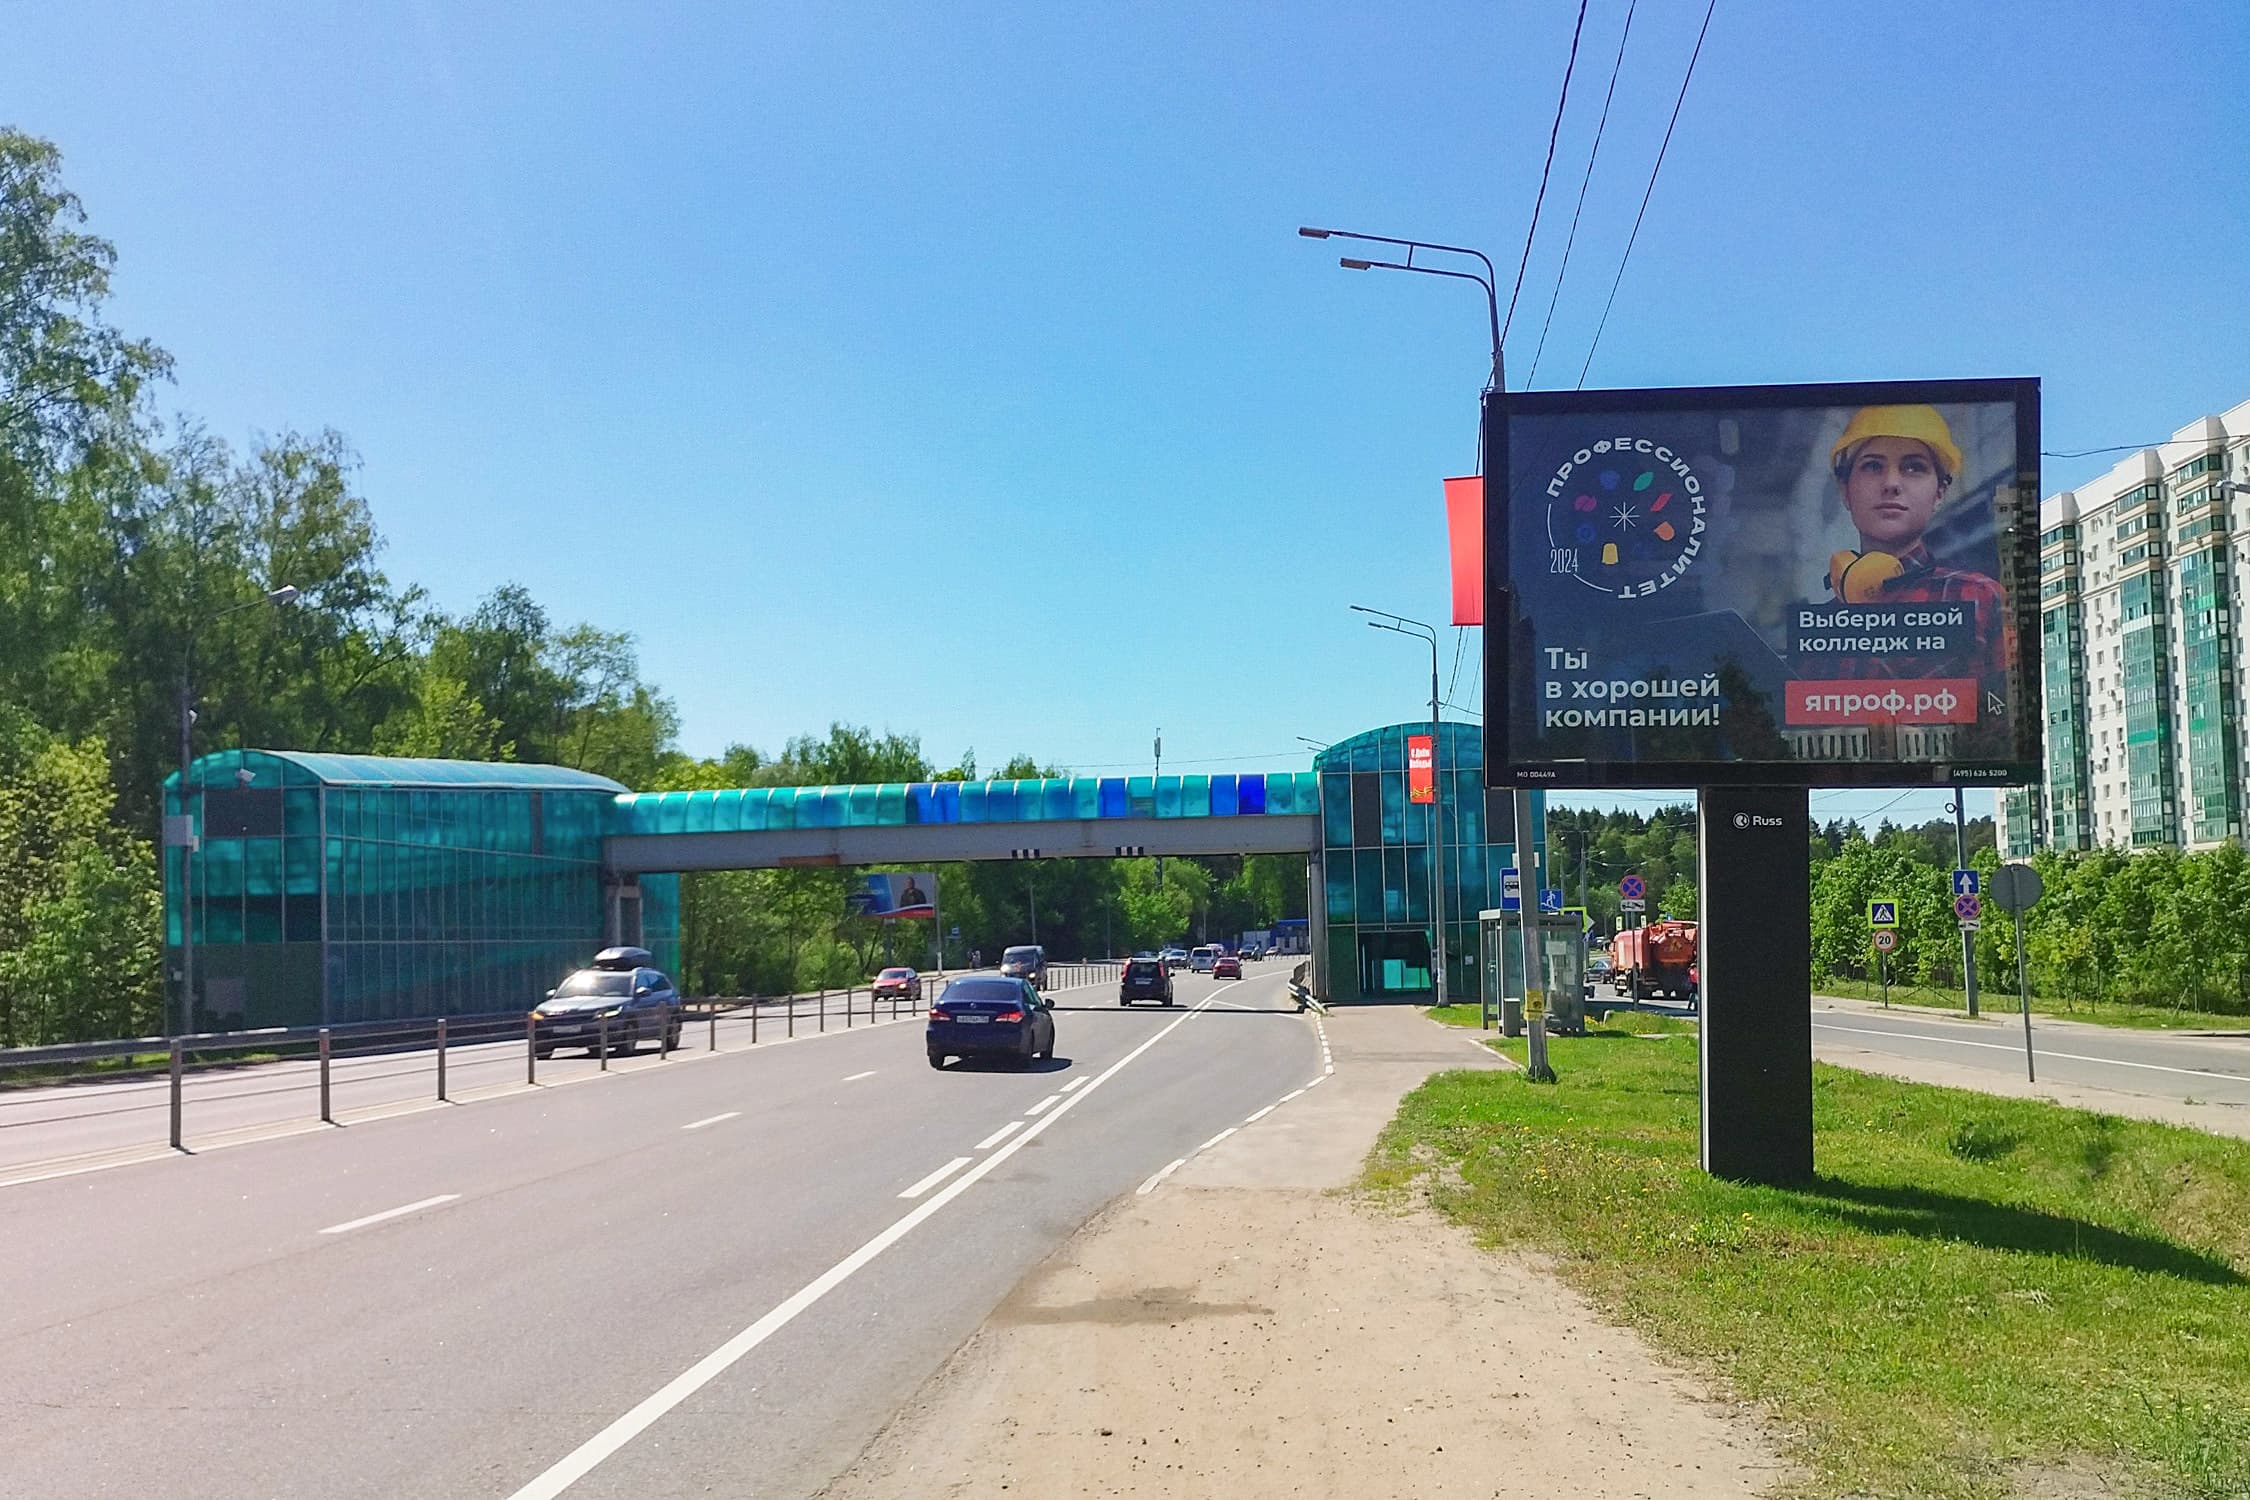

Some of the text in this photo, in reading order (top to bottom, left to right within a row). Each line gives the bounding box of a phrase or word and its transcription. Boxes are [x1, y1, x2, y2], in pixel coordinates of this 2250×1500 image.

[1546, 437, 1706, 599] ПРОФЕССИОНАЛИТЕТ
[1550, 548, 1579, 573] 2024
[1799, 607, 1963, 631] Выбери свой
[1799, 635, 1945, 653] колледж на
[1544, 647, 1588, 670] Ты
[1545, 673, 1720, 704] в хорошей
[1805, 688, 1957, 716] япроф.рф
[1545, 703, 1720, 727] компании!
[1752, 815, 1783, 826] Russ
[1878, 935, 1891, 945] 20
